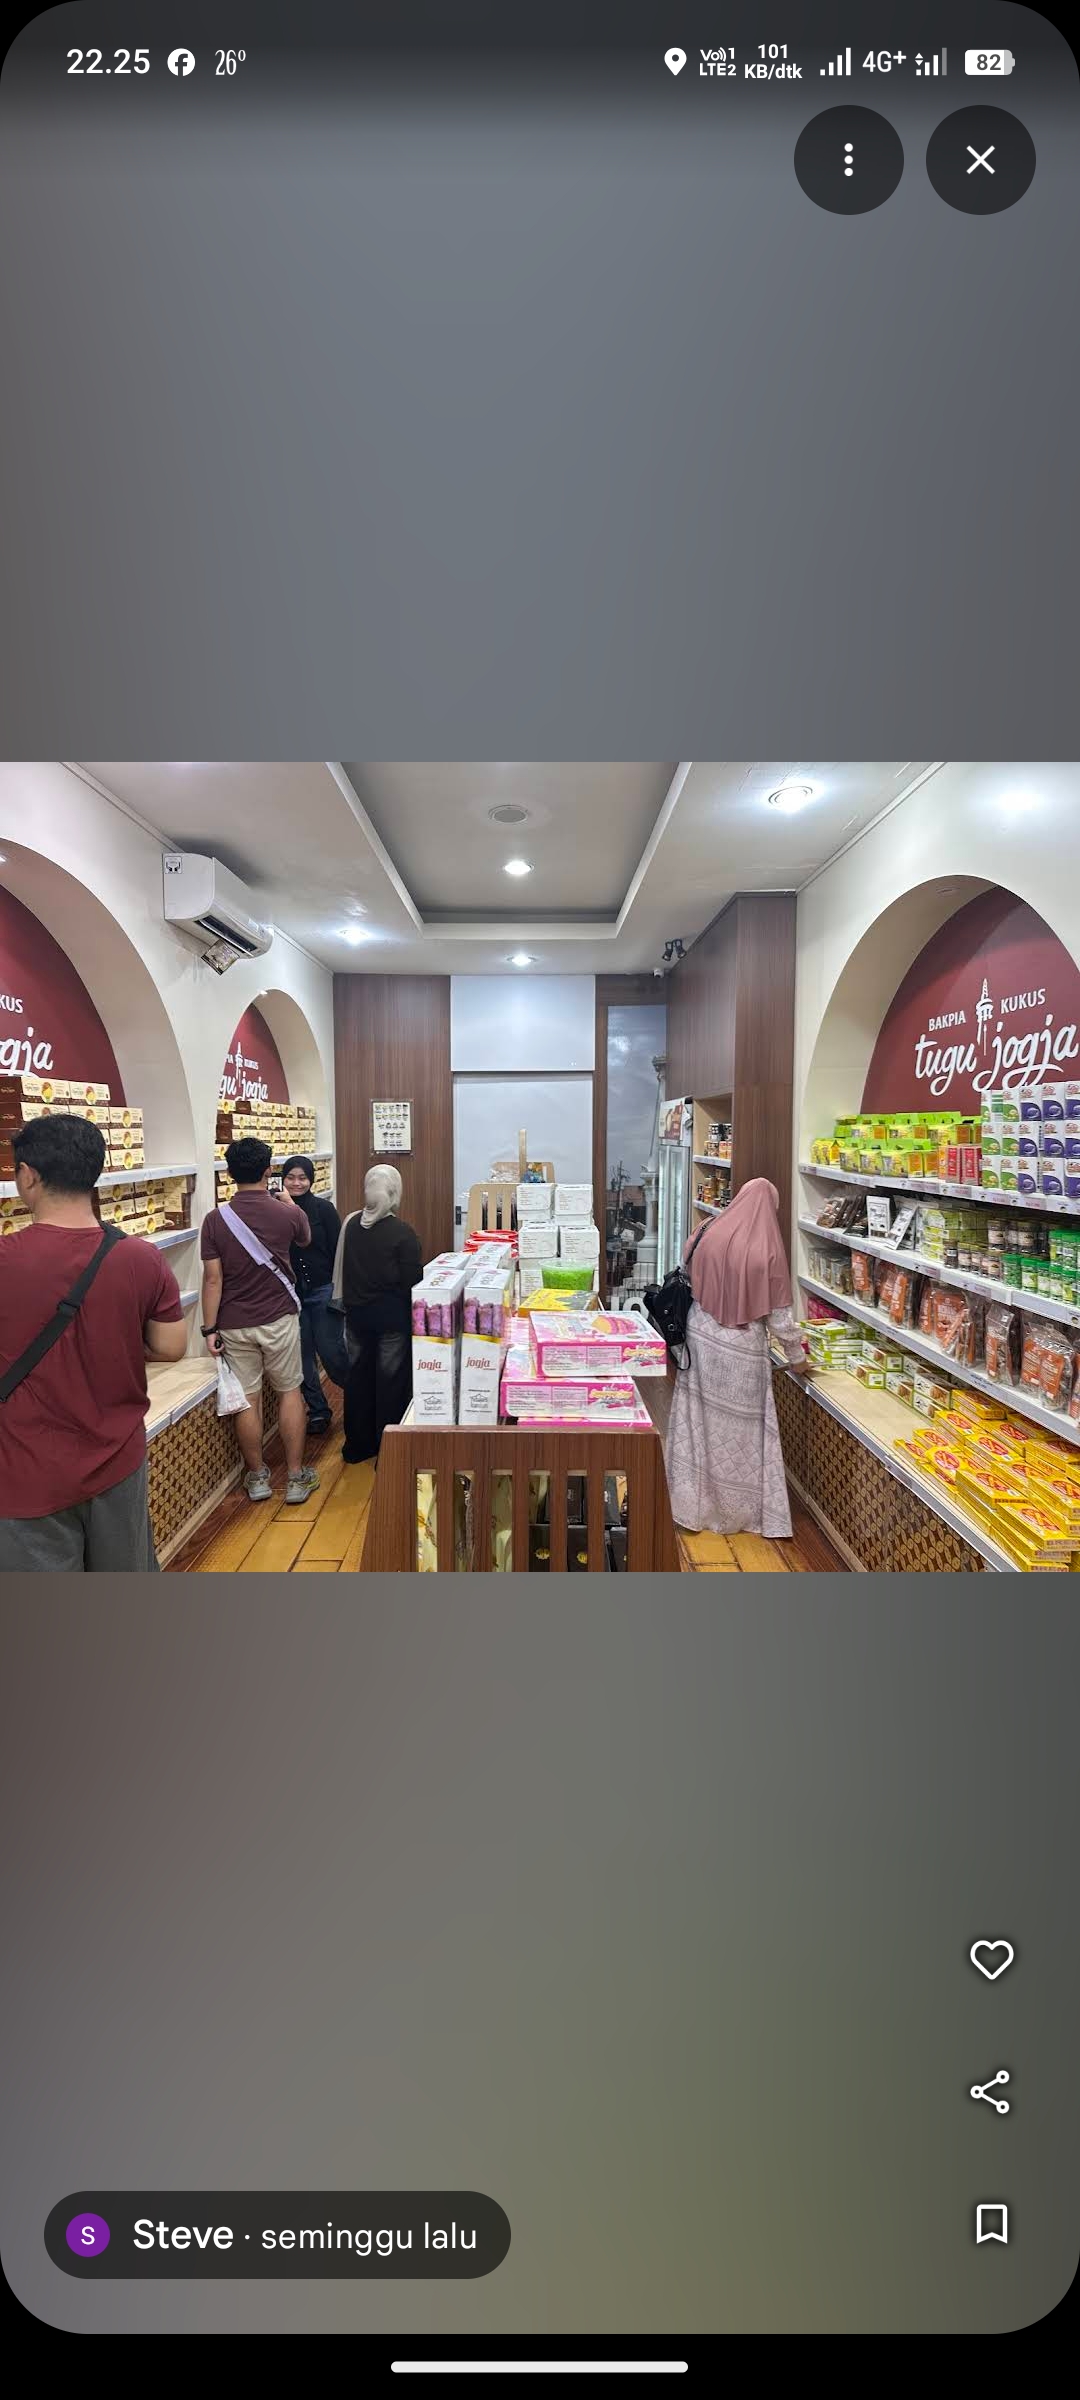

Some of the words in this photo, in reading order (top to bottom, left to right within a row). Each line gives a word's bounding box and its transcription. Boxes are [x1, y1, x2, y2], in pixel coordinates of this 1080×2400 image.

[928, 1010, 966, 1032] BAKPIA
[1000, 988, 1046, 1014] KUKUS
[915, 1033, 977, 1096] tugu
[972, 1014, 1080, 1092] jogja
